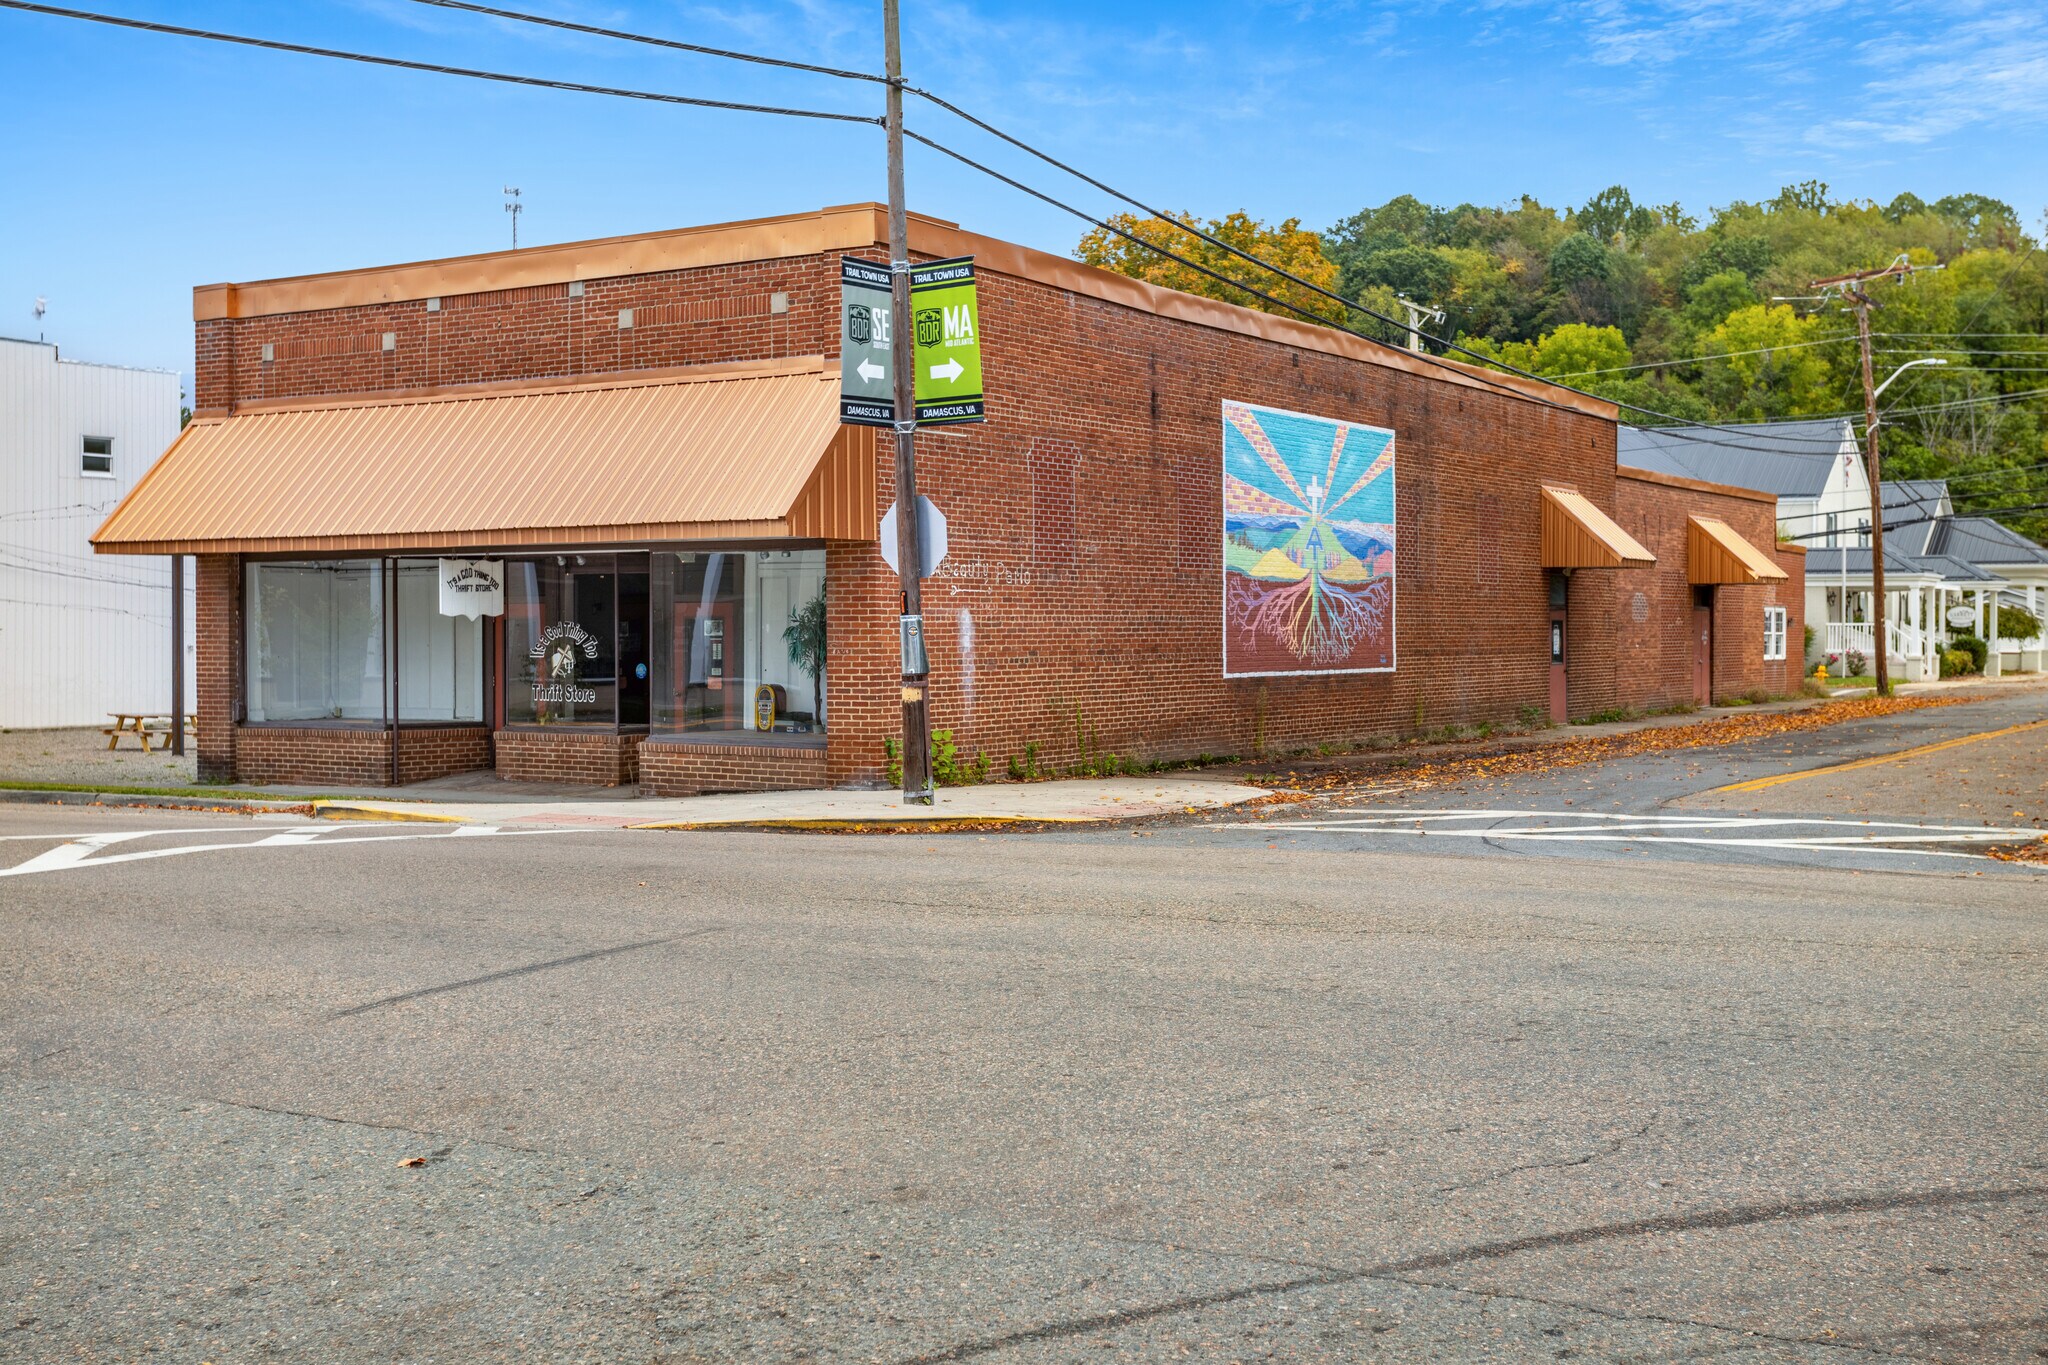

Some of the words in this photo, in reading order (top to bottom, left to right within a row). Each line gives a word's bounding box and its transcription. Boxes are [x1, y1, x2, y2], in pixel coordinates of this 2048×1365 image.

[845, 266, 861, 279] TRAIL
[860, 269, 878, 282] TOWN
[877, 272, 890, 284] USA
[914, 273, 933, 284] TRAIL
[932, 270, 955, 281] TOWN
[954, 267, 970, 278] USA
[851, 317, 869, 341] BDR
[872, 306, 890, 342] SE
[943, 304, 974, 339] MA
[918, 322, 941, 344] BDR
[945, 340, 955, 348] MID
[955, 337, 975, 347] ATLANTIC
[847, 405, 882, 418] DAMASCUS,
[882, 409, 890, 418] VA
[923, 405, 966, 418] DAMASCUS,
[965, 404, 976, 414] VA
[455, 584, 473, 593] THRIFT
[475, 584, 492, 592] STORE
[474, 569, 490, 582] THING
[489, 576, 500, 590] TOO
[539, 635, 551, 646] a
[544, 621, 564, 641] God
[563, 621, 588, 646] Thing
[582, 635, 599, 659] Too
[532, 684, 563, 703] Thrift
[564, 684, 596, 703] Store
